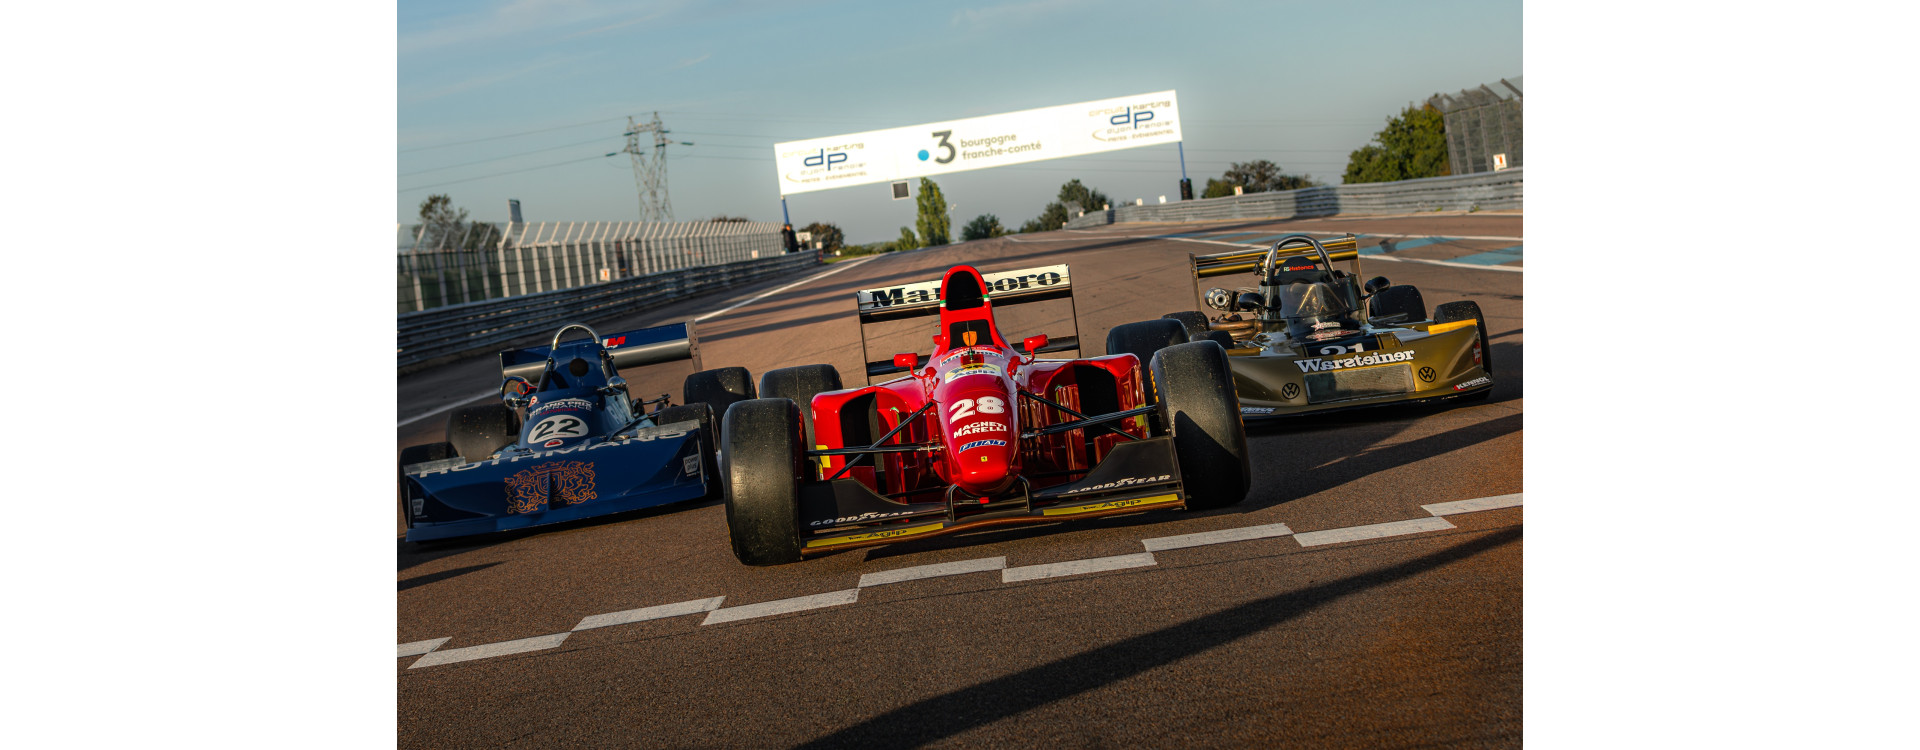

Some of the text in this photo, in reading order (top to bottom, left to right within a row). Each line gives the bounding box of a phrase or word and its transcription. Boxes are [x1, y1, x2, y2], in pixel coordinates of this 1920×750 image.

[1110, 106, 1154, 129] dp
[931, 129, 956, 164] 3
[960, 133, 1016, 149] bourgogne
[962, 141, 1042, 160] franche-comté
[803, 148, 848, 171] dp
[871, 272, 1061, 308] Maoro
[1294, 349, 1415, 373] Warsteiner
[948, 396, 1005, 425] 28
[534, 418, 580, 442] 22
[954, 424, 1007, 439] MARELLI
